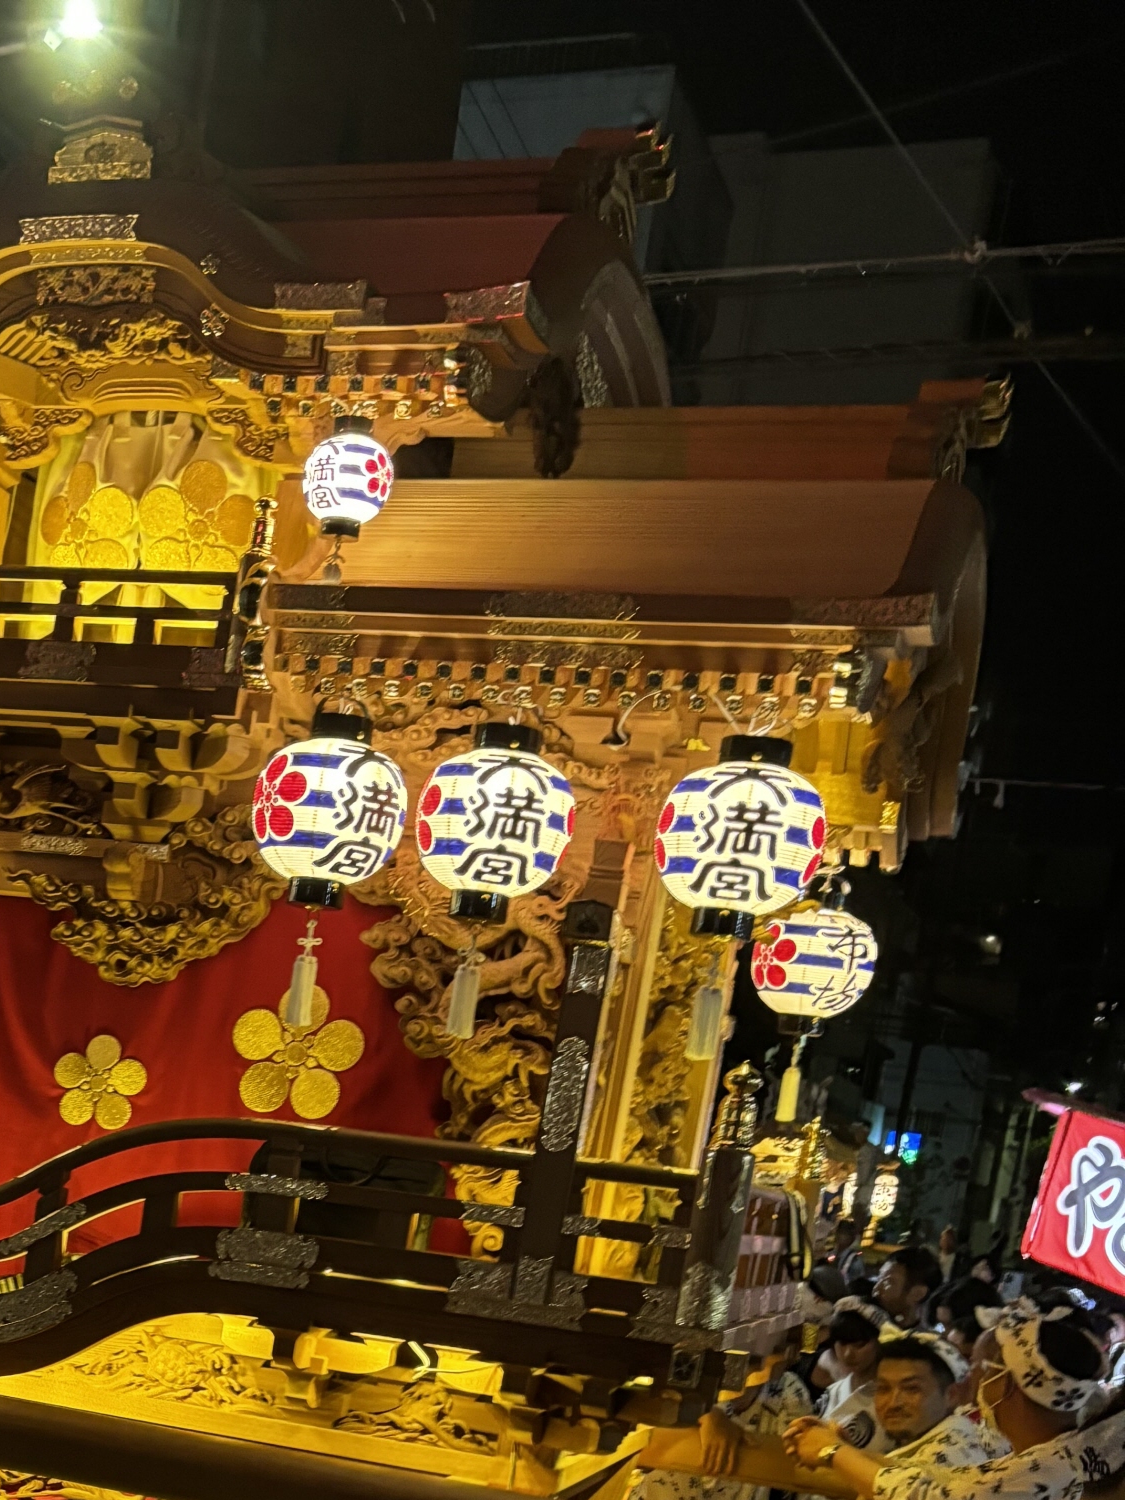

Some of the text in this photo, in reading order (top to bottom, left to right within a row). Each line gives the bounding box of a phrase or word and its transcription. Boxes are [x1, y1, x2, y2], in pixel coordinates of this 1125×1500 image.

[313, 745, 401, 878] 天満宮
[455, 756, 548, 887] 天満宮
[690, 767, 790, 902] 天満宮
[812, 926, 872, 1010] 市場
[1057, 1135, 1124, 1290] や
